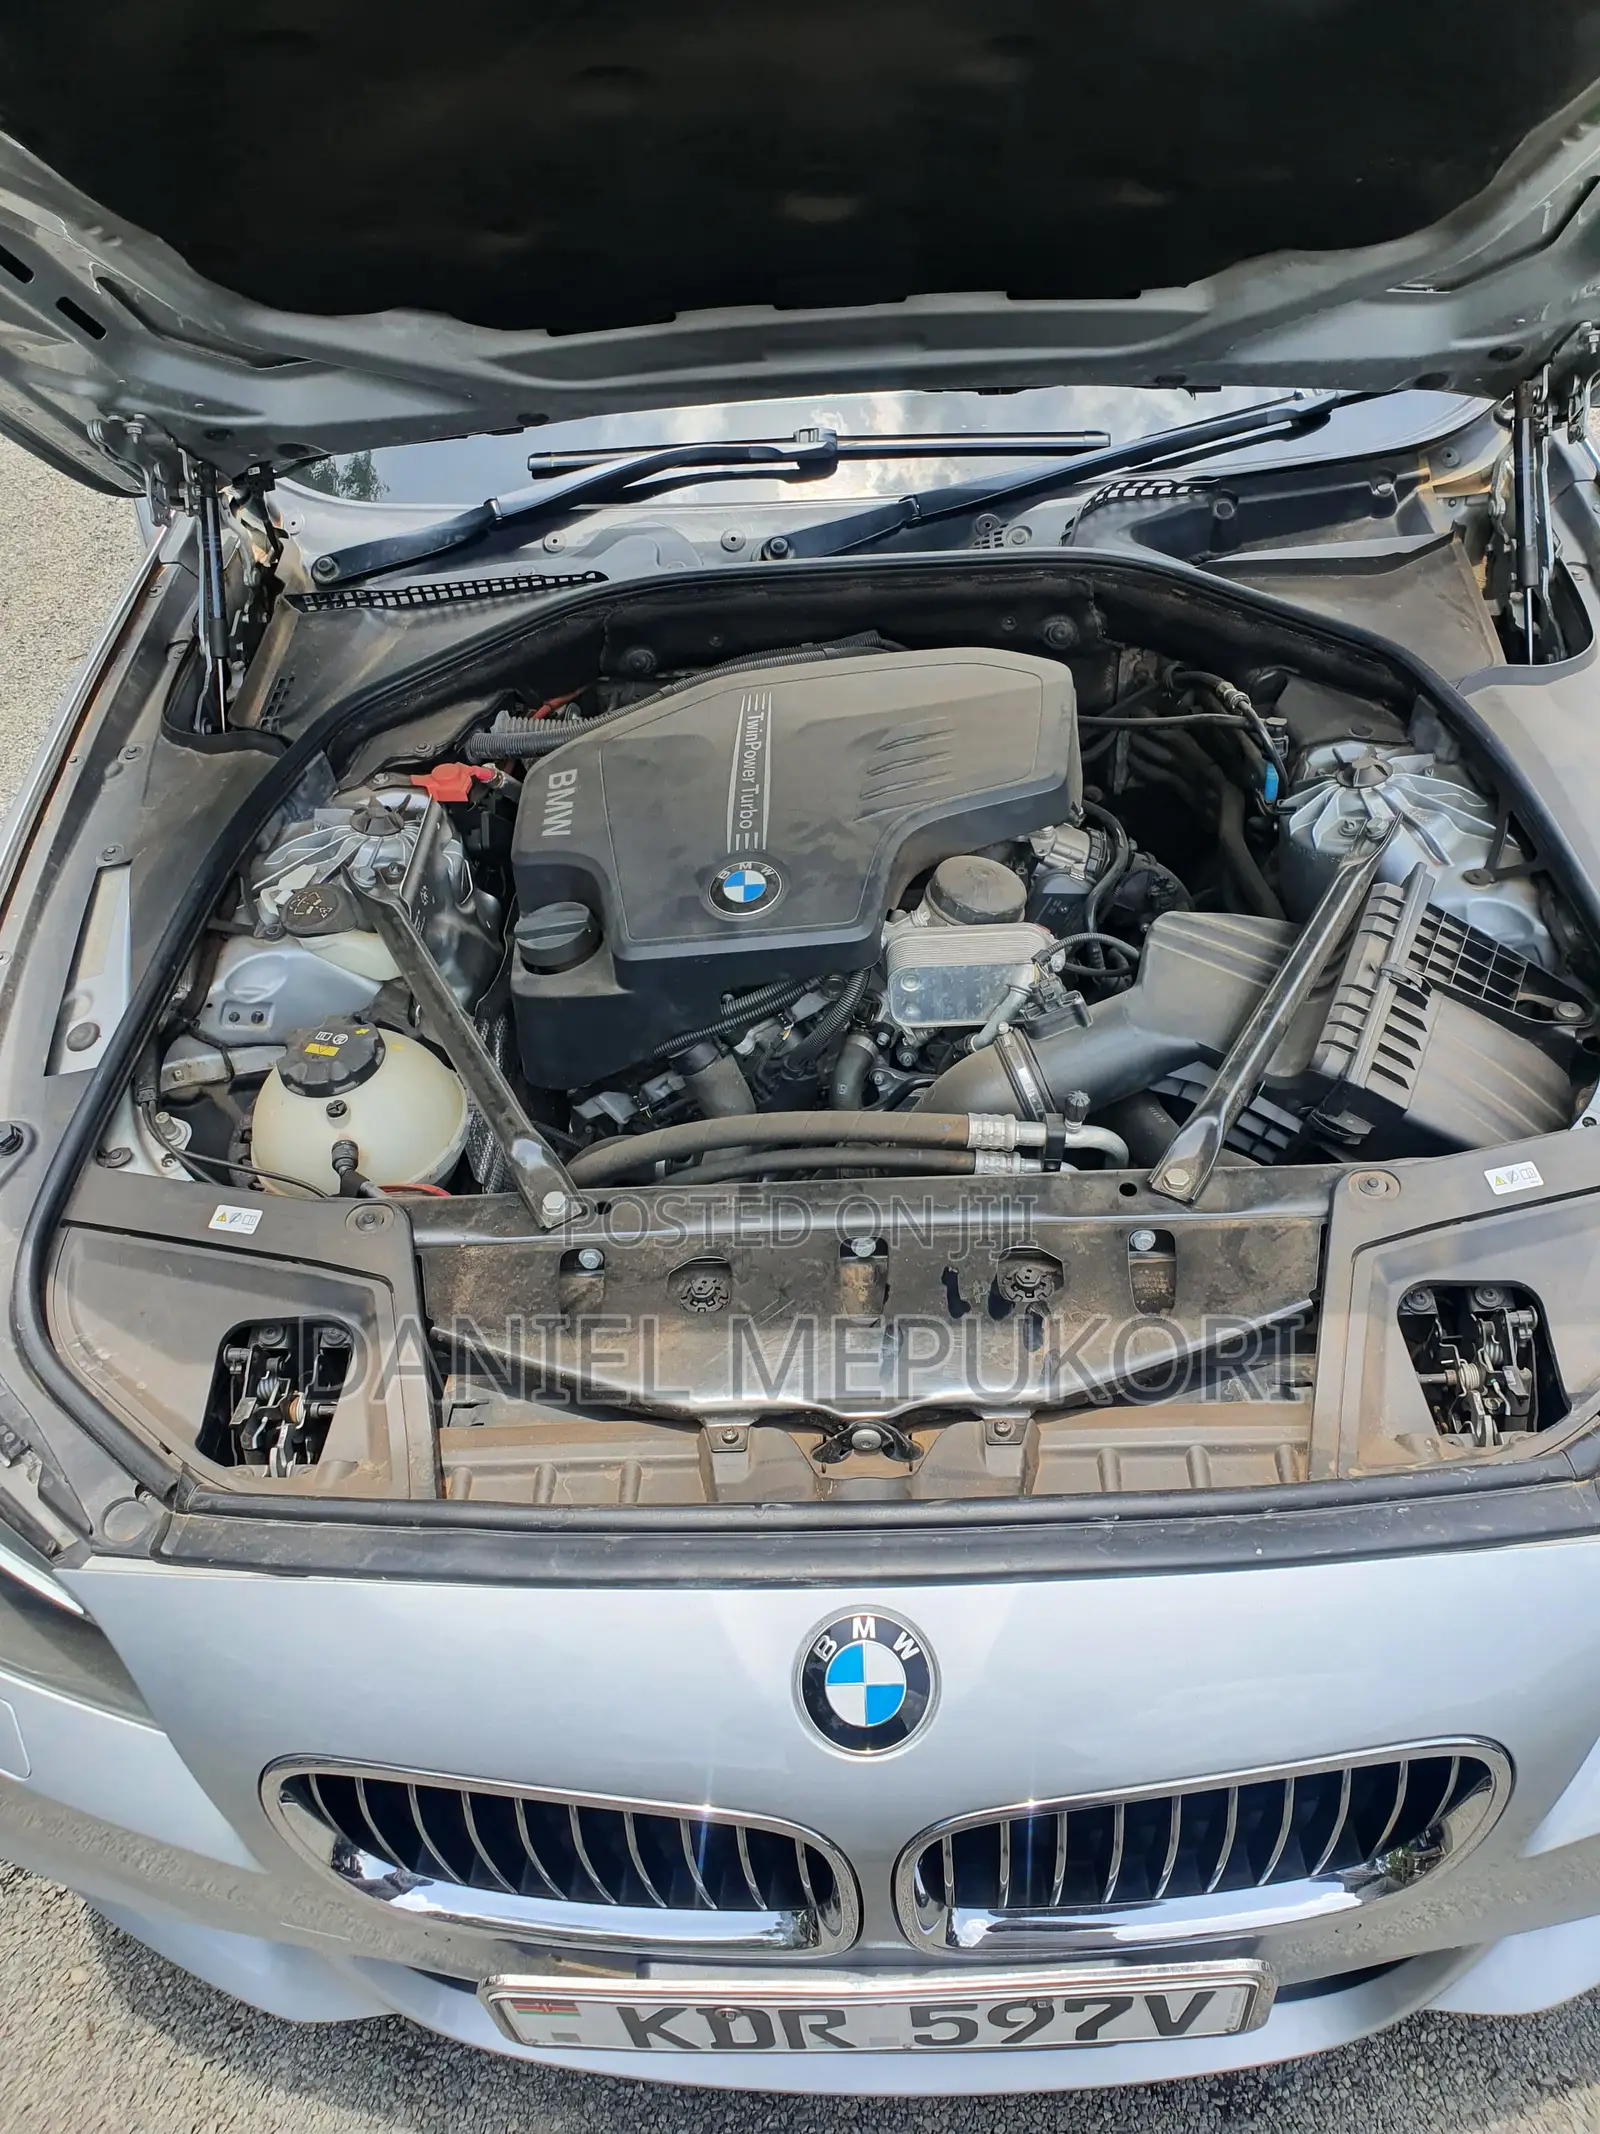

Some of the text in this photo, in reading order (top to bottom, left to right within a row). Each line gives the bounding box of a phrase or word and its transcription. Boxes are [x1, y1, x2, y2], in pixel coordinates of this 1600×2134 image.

[739, 711, 765, 829] TwinPower Turbo
[542, 769, 578, 837] BMW
[718, 862, 775, 880] BMW
[812, 1616, 920, 1662] BMW
[616, 2006, 859, 2049] KDR
[909, 1990, 1217, 2047] 597V
